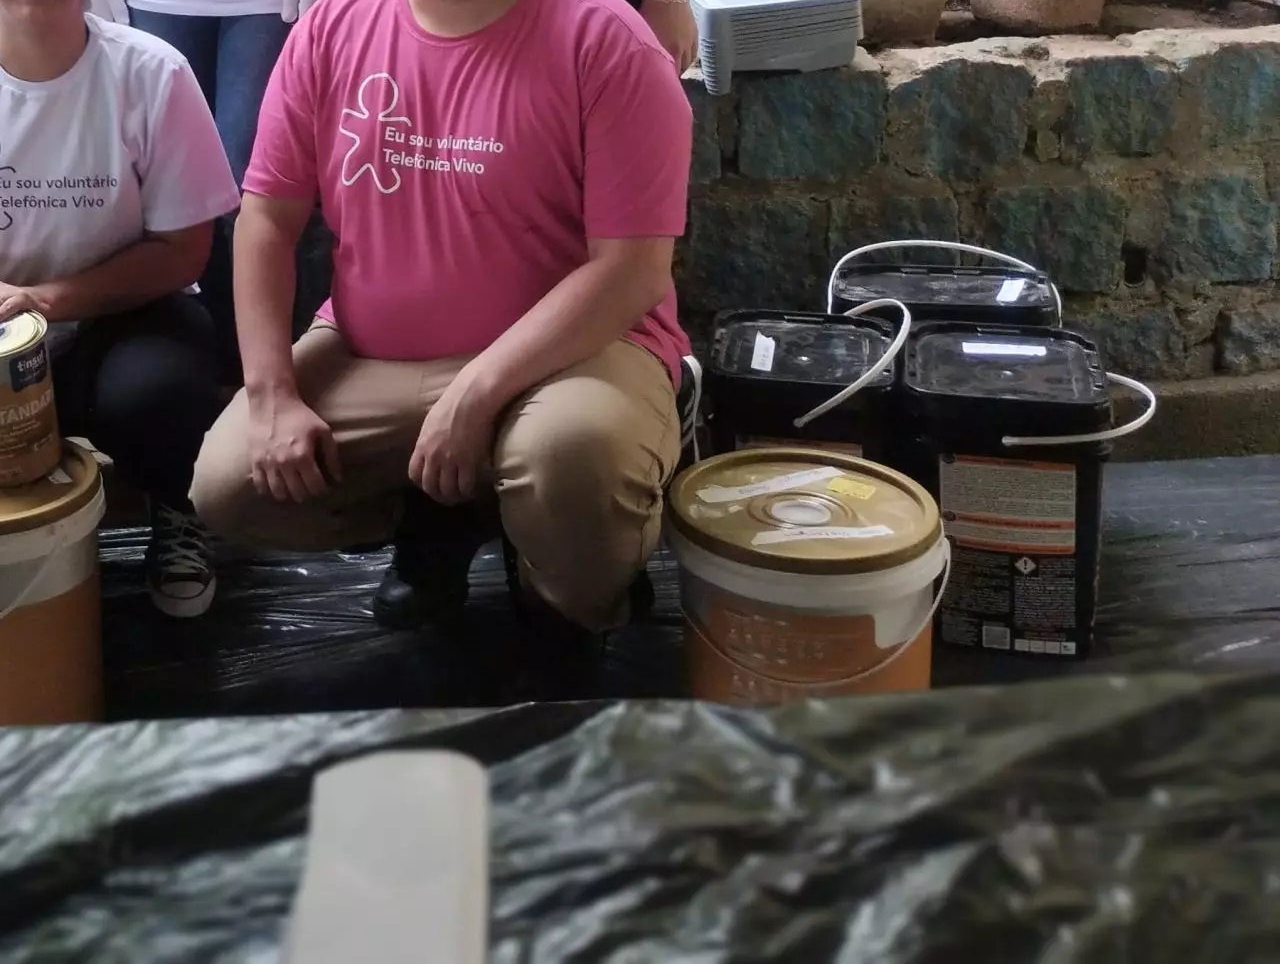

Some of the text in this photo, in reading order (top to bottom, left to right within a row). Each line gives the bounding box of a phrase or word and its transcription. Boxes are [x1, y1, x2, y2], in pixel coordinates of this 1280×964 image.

[384, 126, 405, 145] Eu
[409, 133, 433, 148] sou
[382, 148, 485, 175] Telefônica Vivo
[16, 177, 41, 189] sou
[45, 174, 118, 189] voluntário
[71, 195, 105, 208] Vivo
